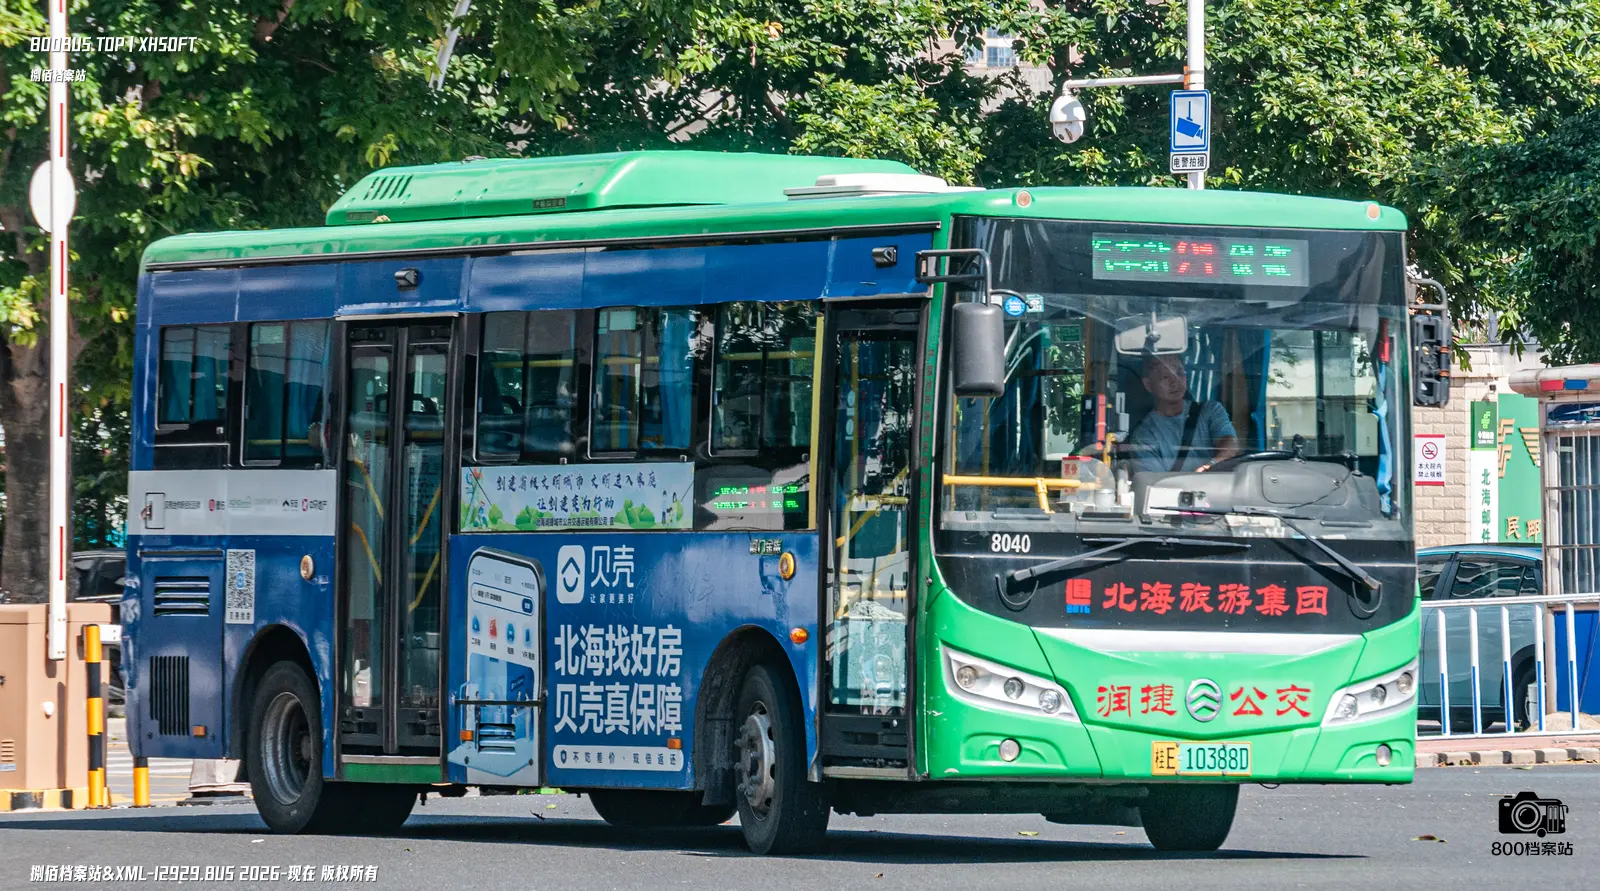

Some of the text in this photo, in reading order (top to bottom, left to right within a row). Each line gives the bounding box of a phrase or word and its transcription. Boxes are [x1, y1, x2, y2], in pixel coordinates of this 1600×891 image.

[1173, 156, 1205, 168] 电警拍摄
[991, 533, 1031, 553] 8040
[590, 544, 635, 588] 贝壳
[590, 593, 634, 604] 让家更美好
[1102, 581, 1329, 616] 北海旅游集团
[554, 624, 683, 677] 北海找好房
[554, 681, 683, 736] 贝壳真保障
[1097, 683, 1312, 718] 润捷 公交
